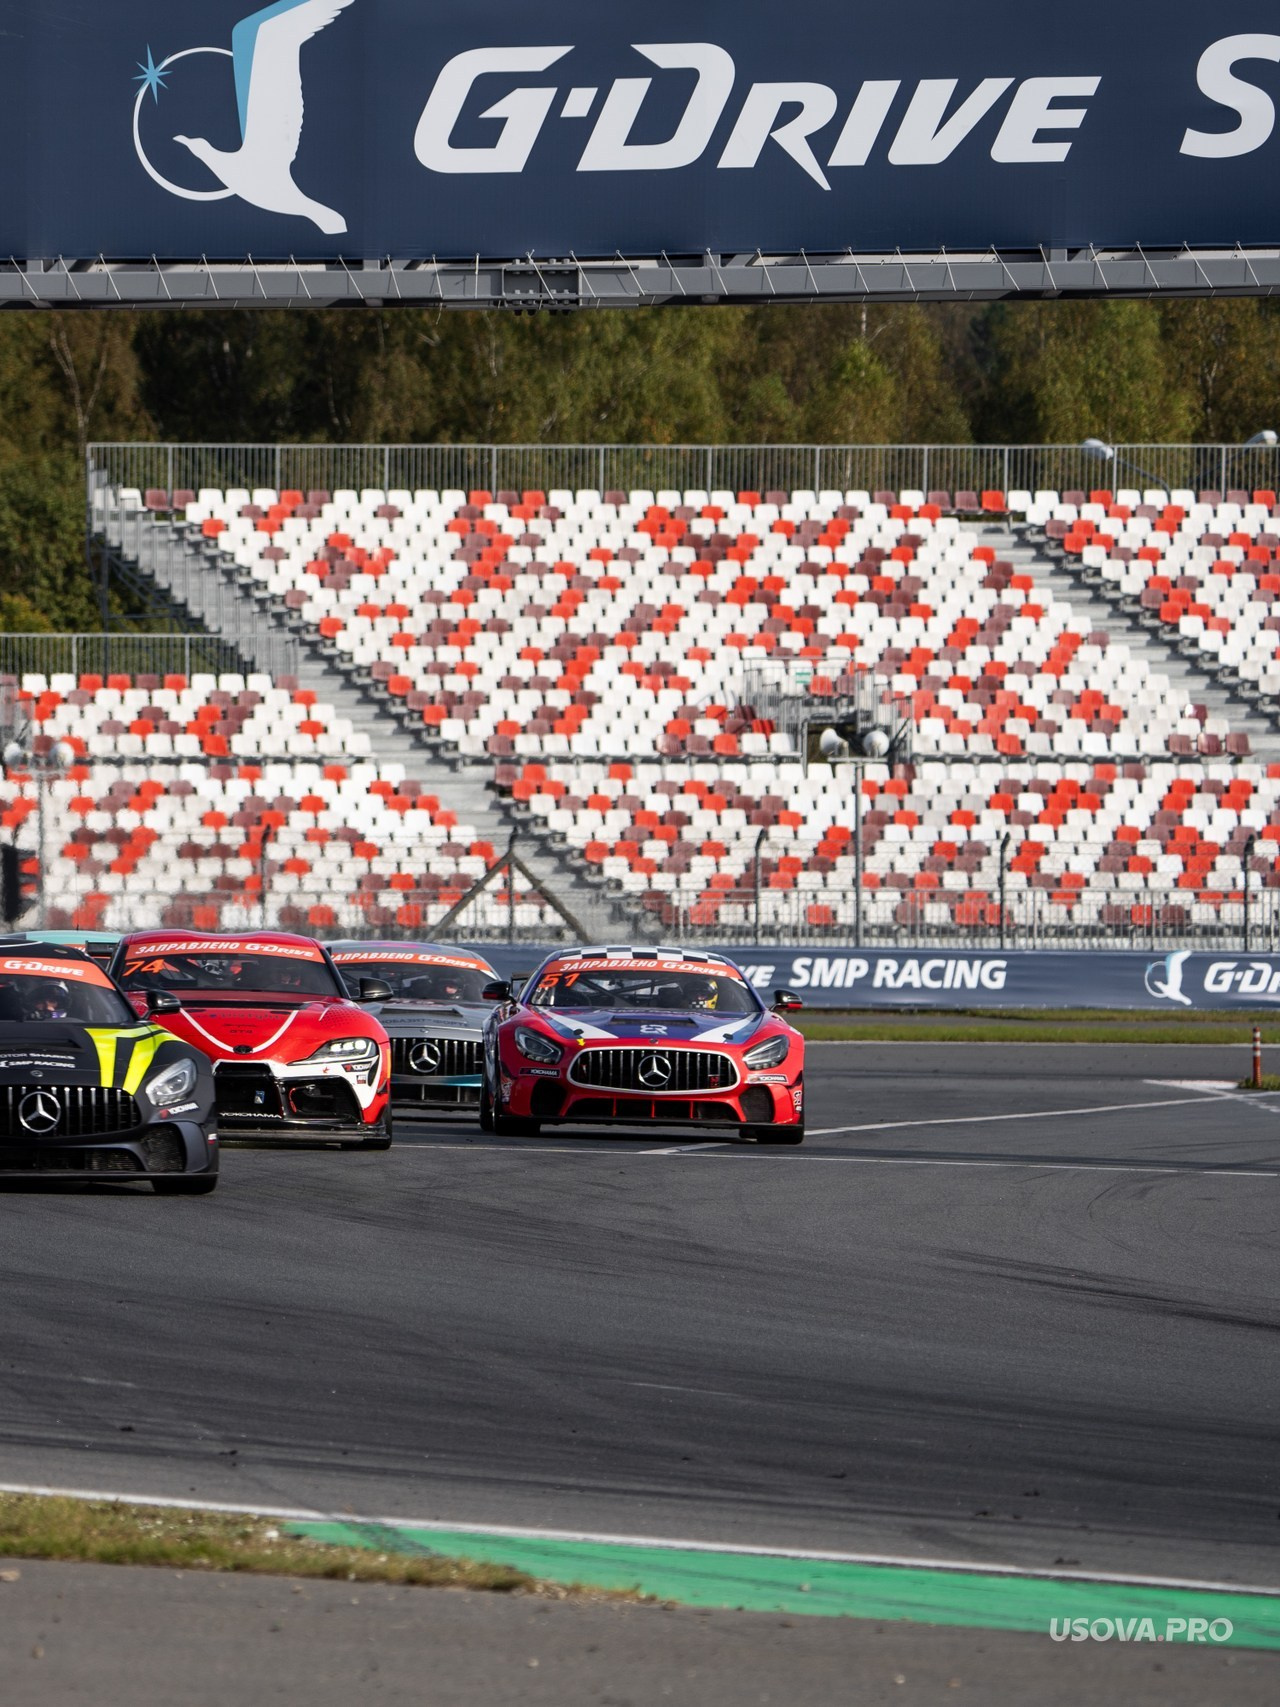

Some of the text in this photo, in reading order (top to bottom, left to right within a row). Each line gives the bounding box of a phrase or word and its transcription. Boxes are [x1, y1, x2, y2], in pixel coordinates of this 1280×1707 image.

[135, 942, 239, 955] ЗАПРАВЛЕНО
[123, 959, 165, 977] 74
[559, 959, 658, 972] ЗАПРАВЛЕНО
[539, 973, 580, 988] 51
[789, 957, 868, 989] SMP
[873, 959, 1007, 990] RACING
